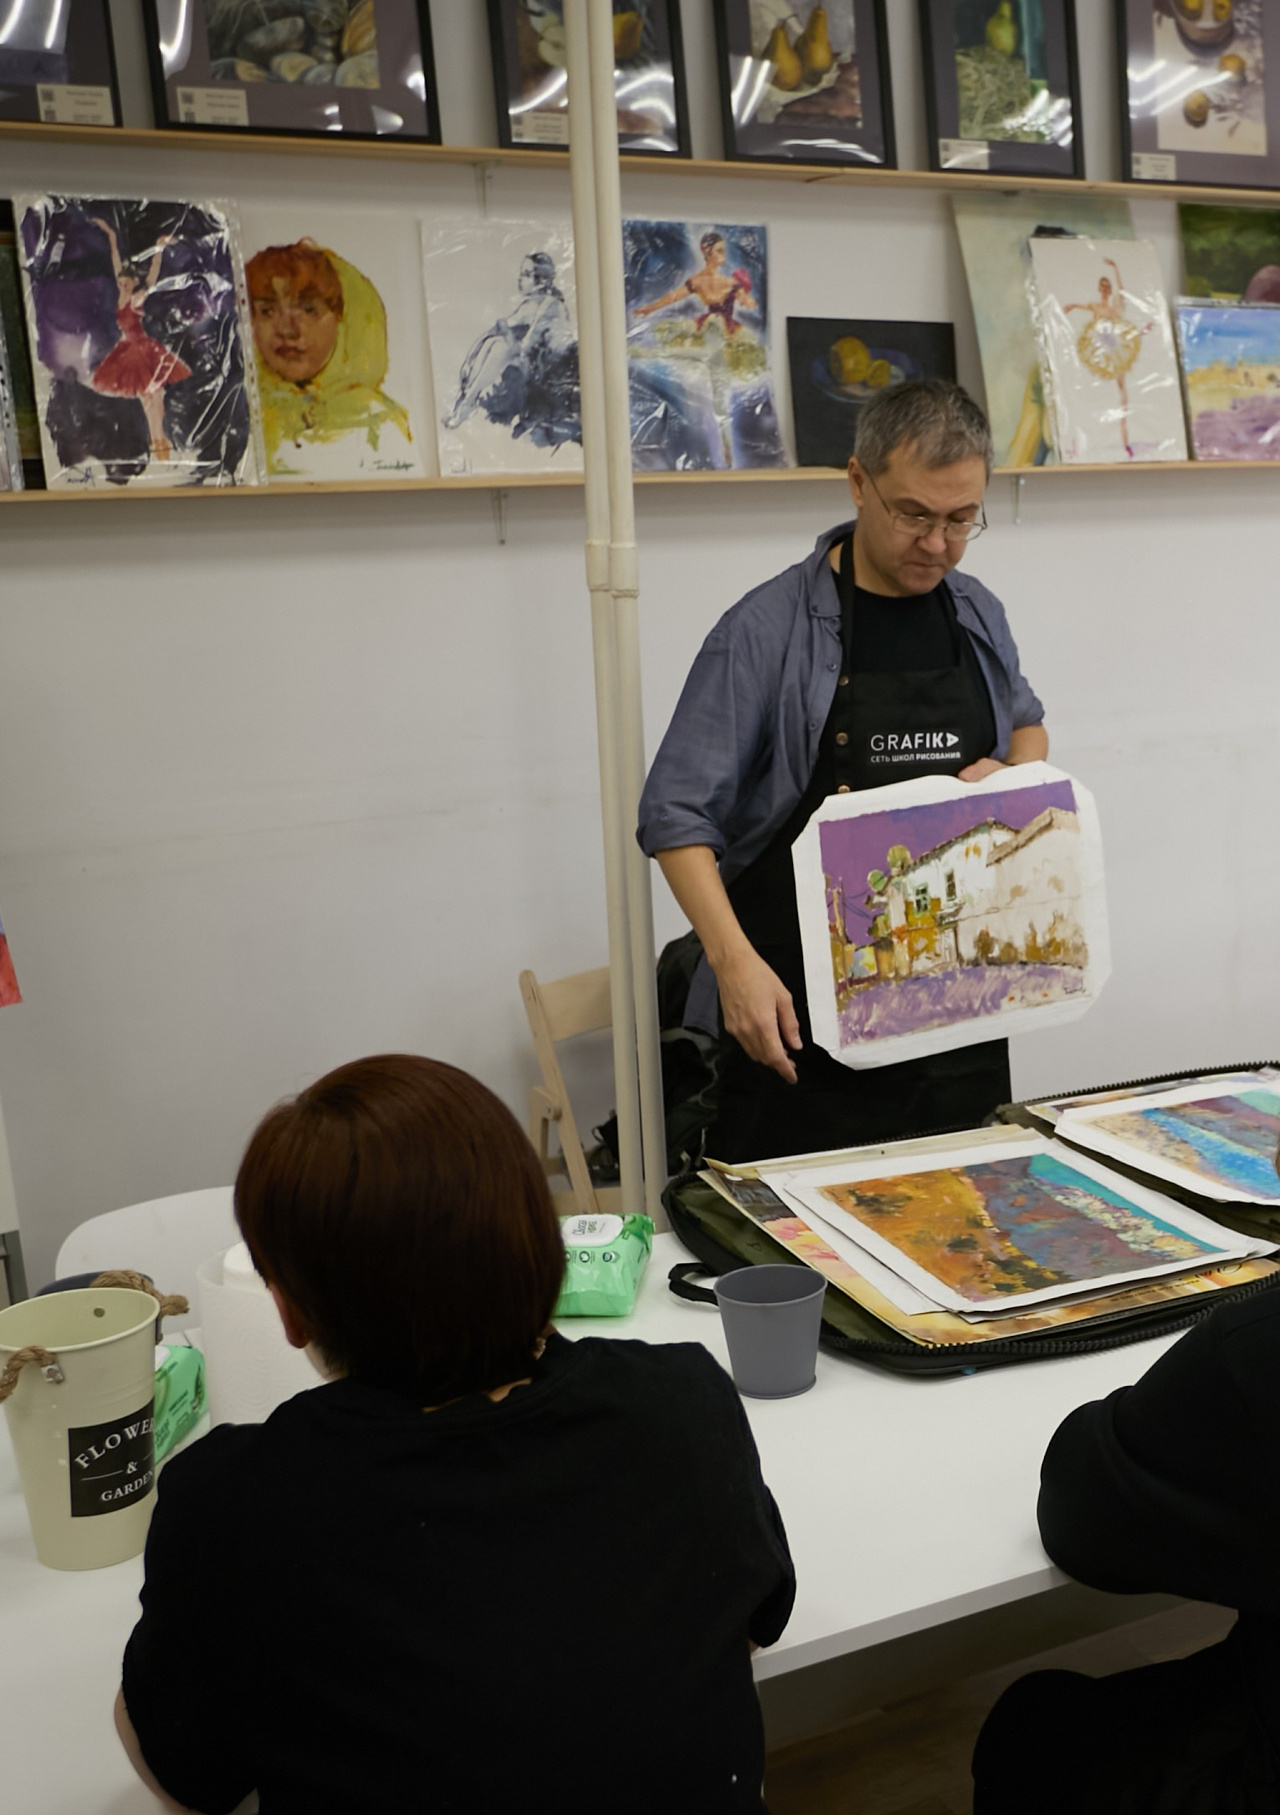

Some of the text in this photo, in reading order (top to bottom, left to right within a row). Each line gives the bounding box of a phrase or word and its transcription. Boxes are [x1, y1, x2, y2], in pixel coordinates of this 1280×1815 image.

[870, 752, 961, 763] СЕТЬ ШКОЛ РИСОВАНИЯ
[126, 1461, 138, 1474] &
